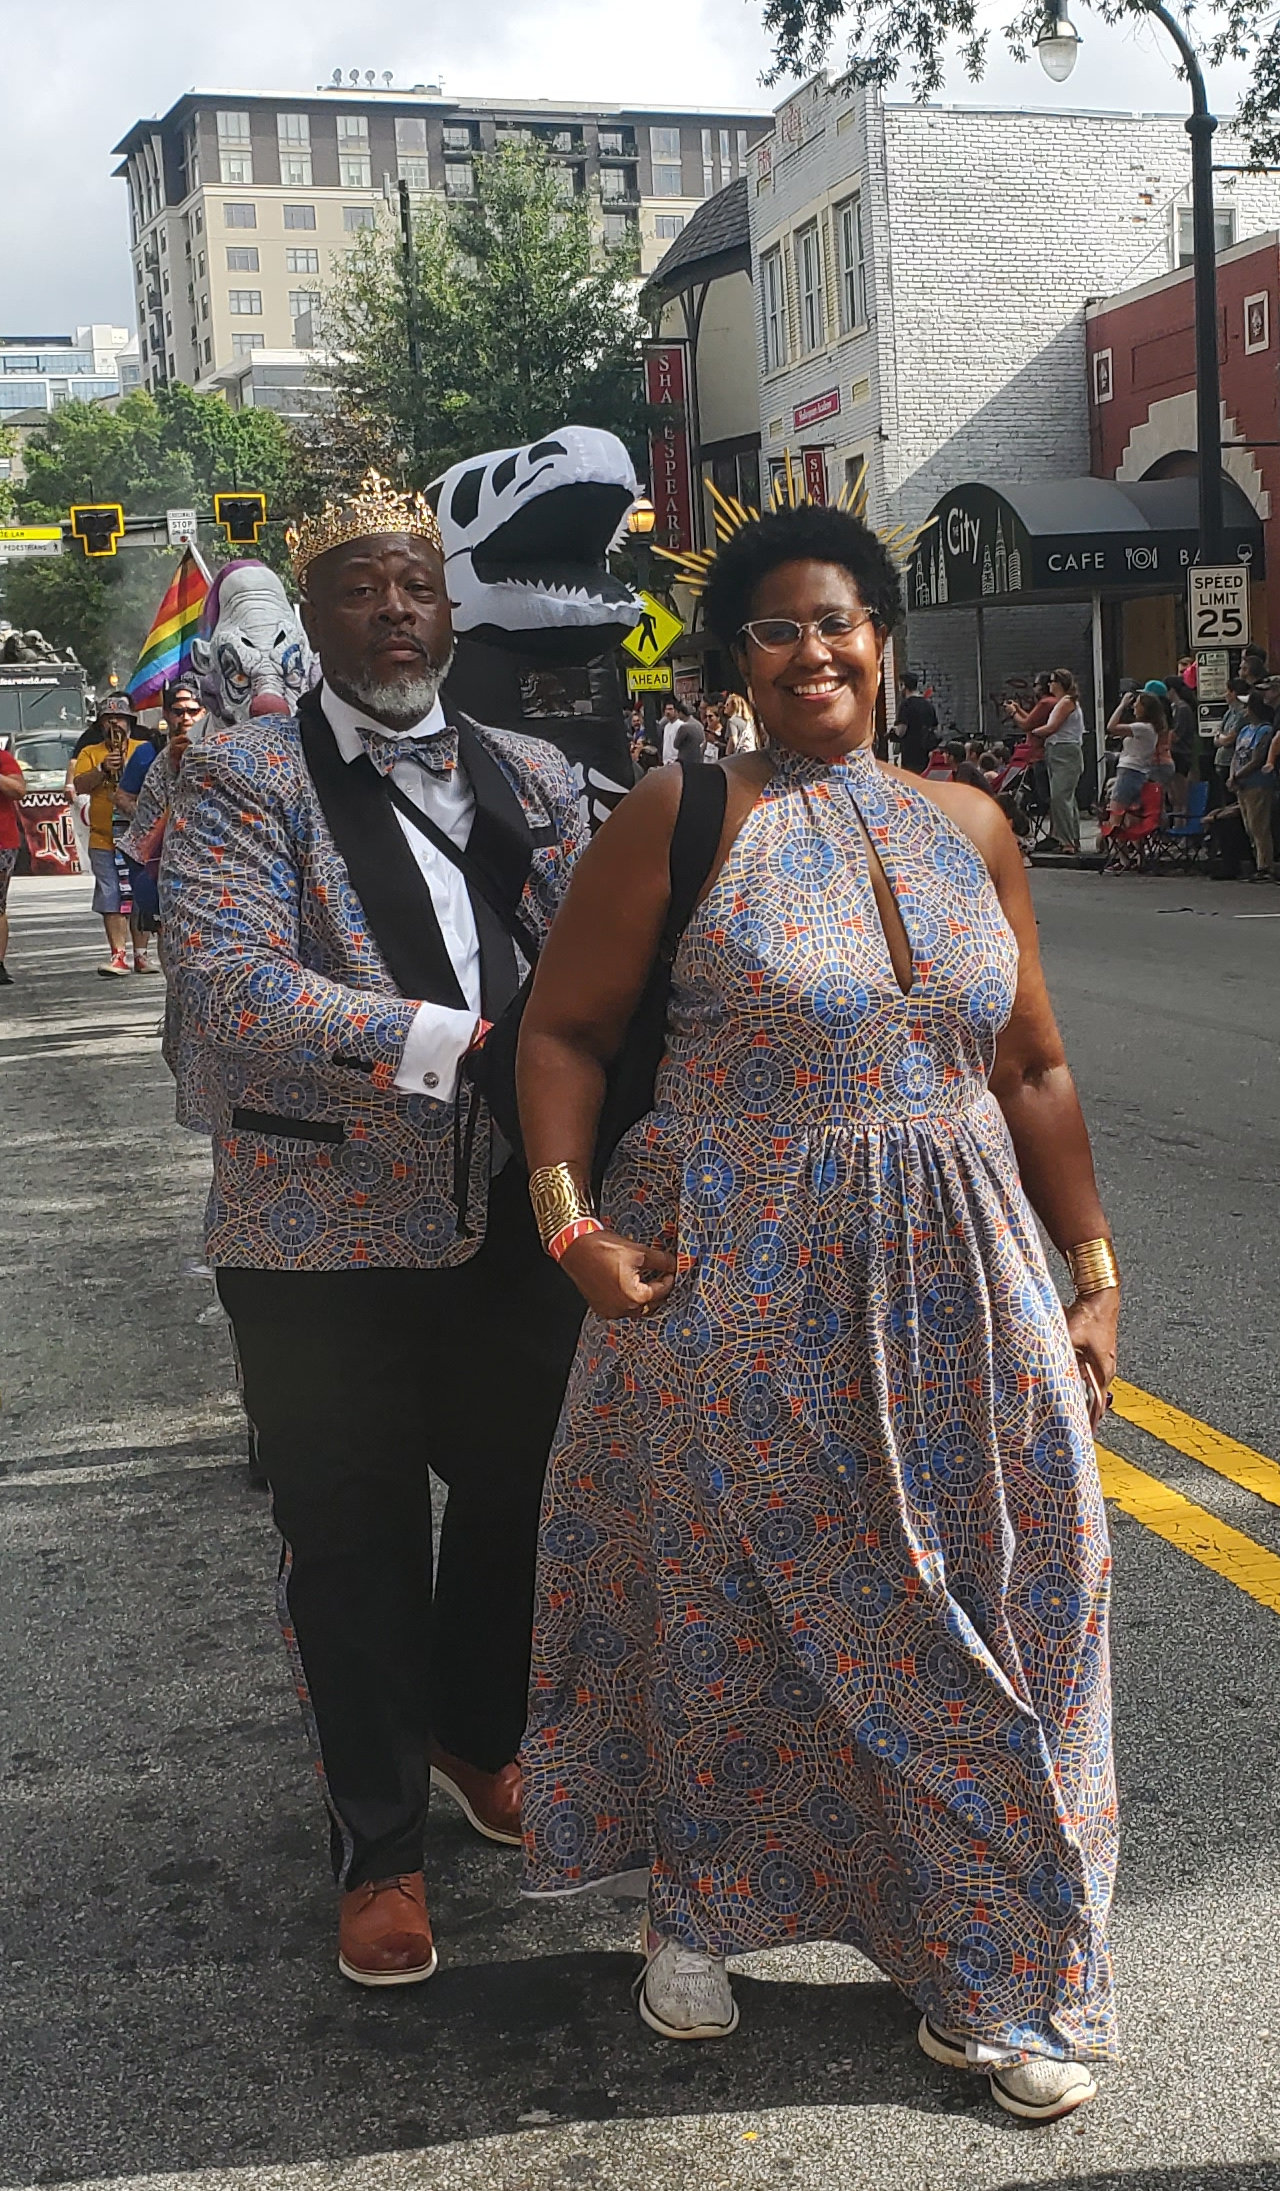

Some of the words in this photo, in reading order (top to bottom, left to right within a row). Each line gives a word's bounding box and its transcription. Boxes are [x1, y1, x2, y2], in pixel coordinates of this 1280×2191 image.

[658, 355, 680, 549] SHAESPEARE
[947, 507, 980, 564] City
[1048, 552, 1104, 571] CAFE
[1195, 576, 1243, 589] SPEED
[1200, 593, 1238, 605] LIMIT
[1197, 608, 1242, 638] 25
[632, 674, 668, 685] AHEAD
